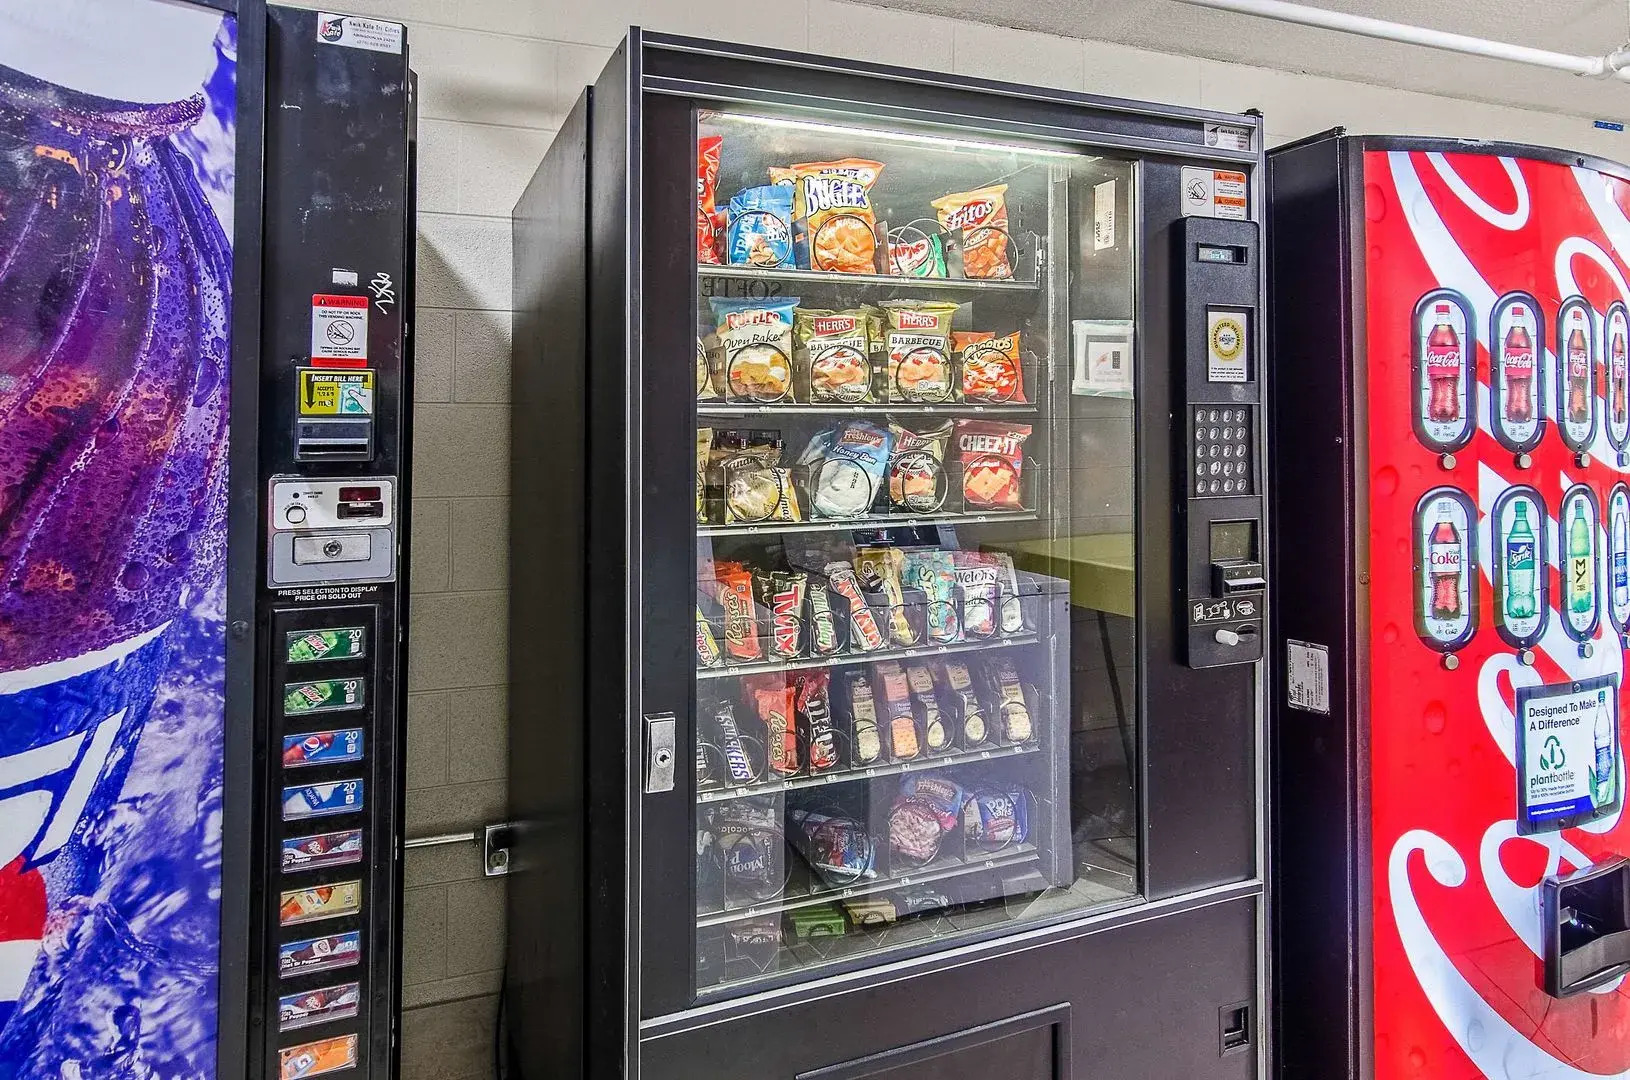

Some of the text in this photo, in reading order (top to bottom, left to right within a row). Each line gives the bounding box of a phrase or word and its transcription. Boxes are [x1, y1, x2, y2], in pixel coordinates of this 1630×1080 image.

[328, 299, 366, 307] WARNING
[817, 318, 851, 332] HERR'S
[902, 315, 935, 327] HERR'S
[723, 338, 750, 350] Oven
[891, 336, 942, 346] BARBECUE
[1427, 350, 1460, 368] Coca-Cola
[1504, 352, 1532, 368] Coca-Cola
[312, 374, 334, 382] INSERT
[833, 446, 860, 459] Honey
[860, 452, 877, 465] Bun
[1430, 552, 1459, 565] Coke
[773, 584, 800, 653] TWIX
[349, 630, 362, 638] 20
[344, 681, 356, 690] 20
[1529, 700, 1596, 718] Designed To Make
[1530, 718, 1580, 731] A Difference
[345, 731, 358, 740] 20
[784, 780, 793, 788] E4
[1530, 770, 1574, 788] plantbottle
[344, 782, 356, 792] 20
